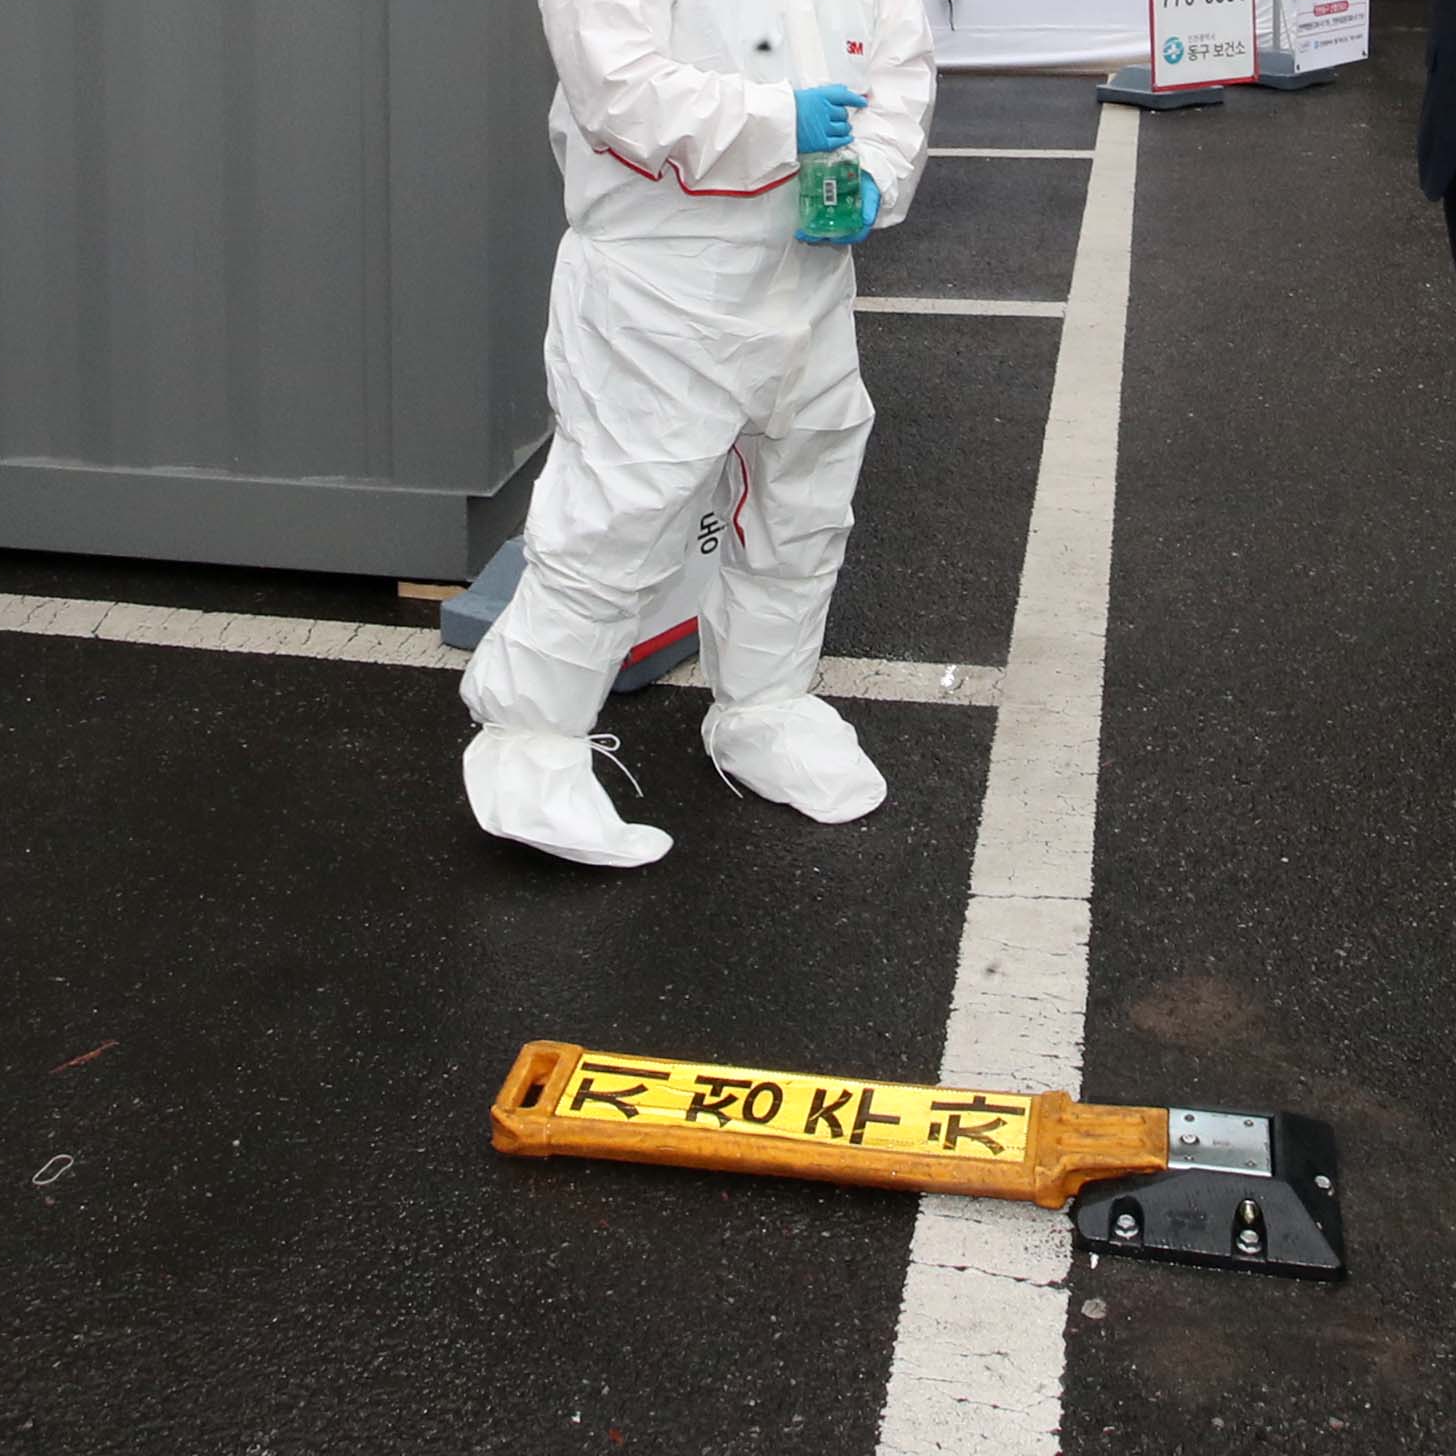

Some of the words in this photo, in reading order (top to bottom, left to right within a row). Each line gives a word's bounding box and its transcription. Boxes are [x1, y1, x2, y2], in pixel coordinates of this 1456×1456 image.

[846, 40, 864, 56] 3M
[1187, 43, 1210, 62] 동구
[1212, 40, 1247, 58] 보건소
[570, 1061, 1029, 1157] 지정주차
